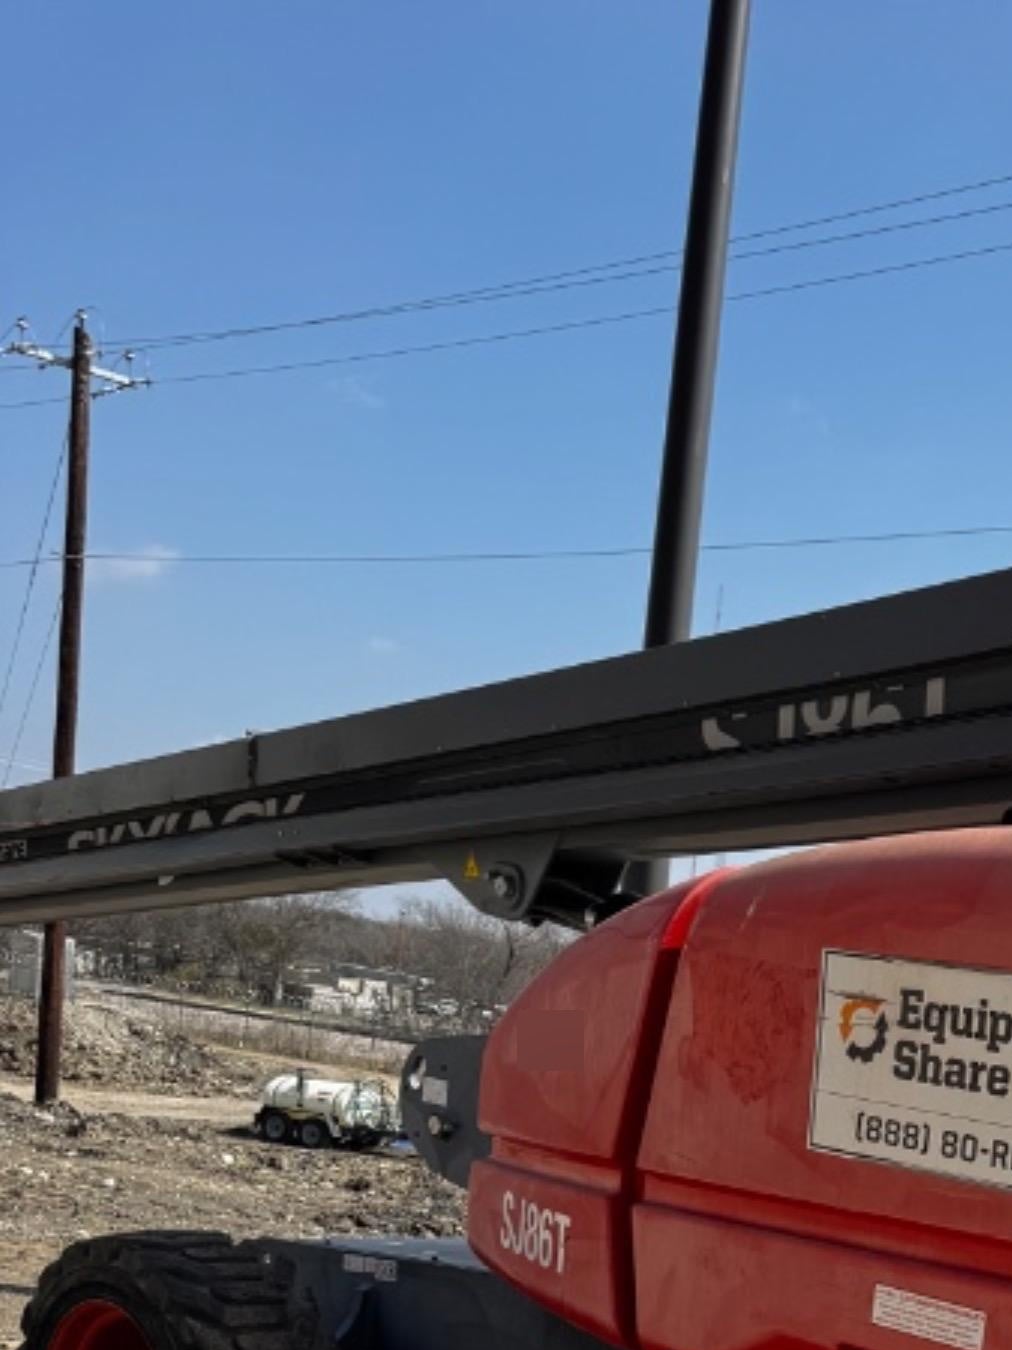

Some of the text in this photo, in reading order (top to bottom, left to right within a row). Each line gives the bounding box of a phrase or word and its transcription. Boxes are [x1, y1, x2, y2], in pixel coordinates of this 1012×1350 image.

[892, 1040, 1011, 1096] Share
[855, 1111, 930, 1155] (888)
[500, 1190, 571, 1273] SJ86T
